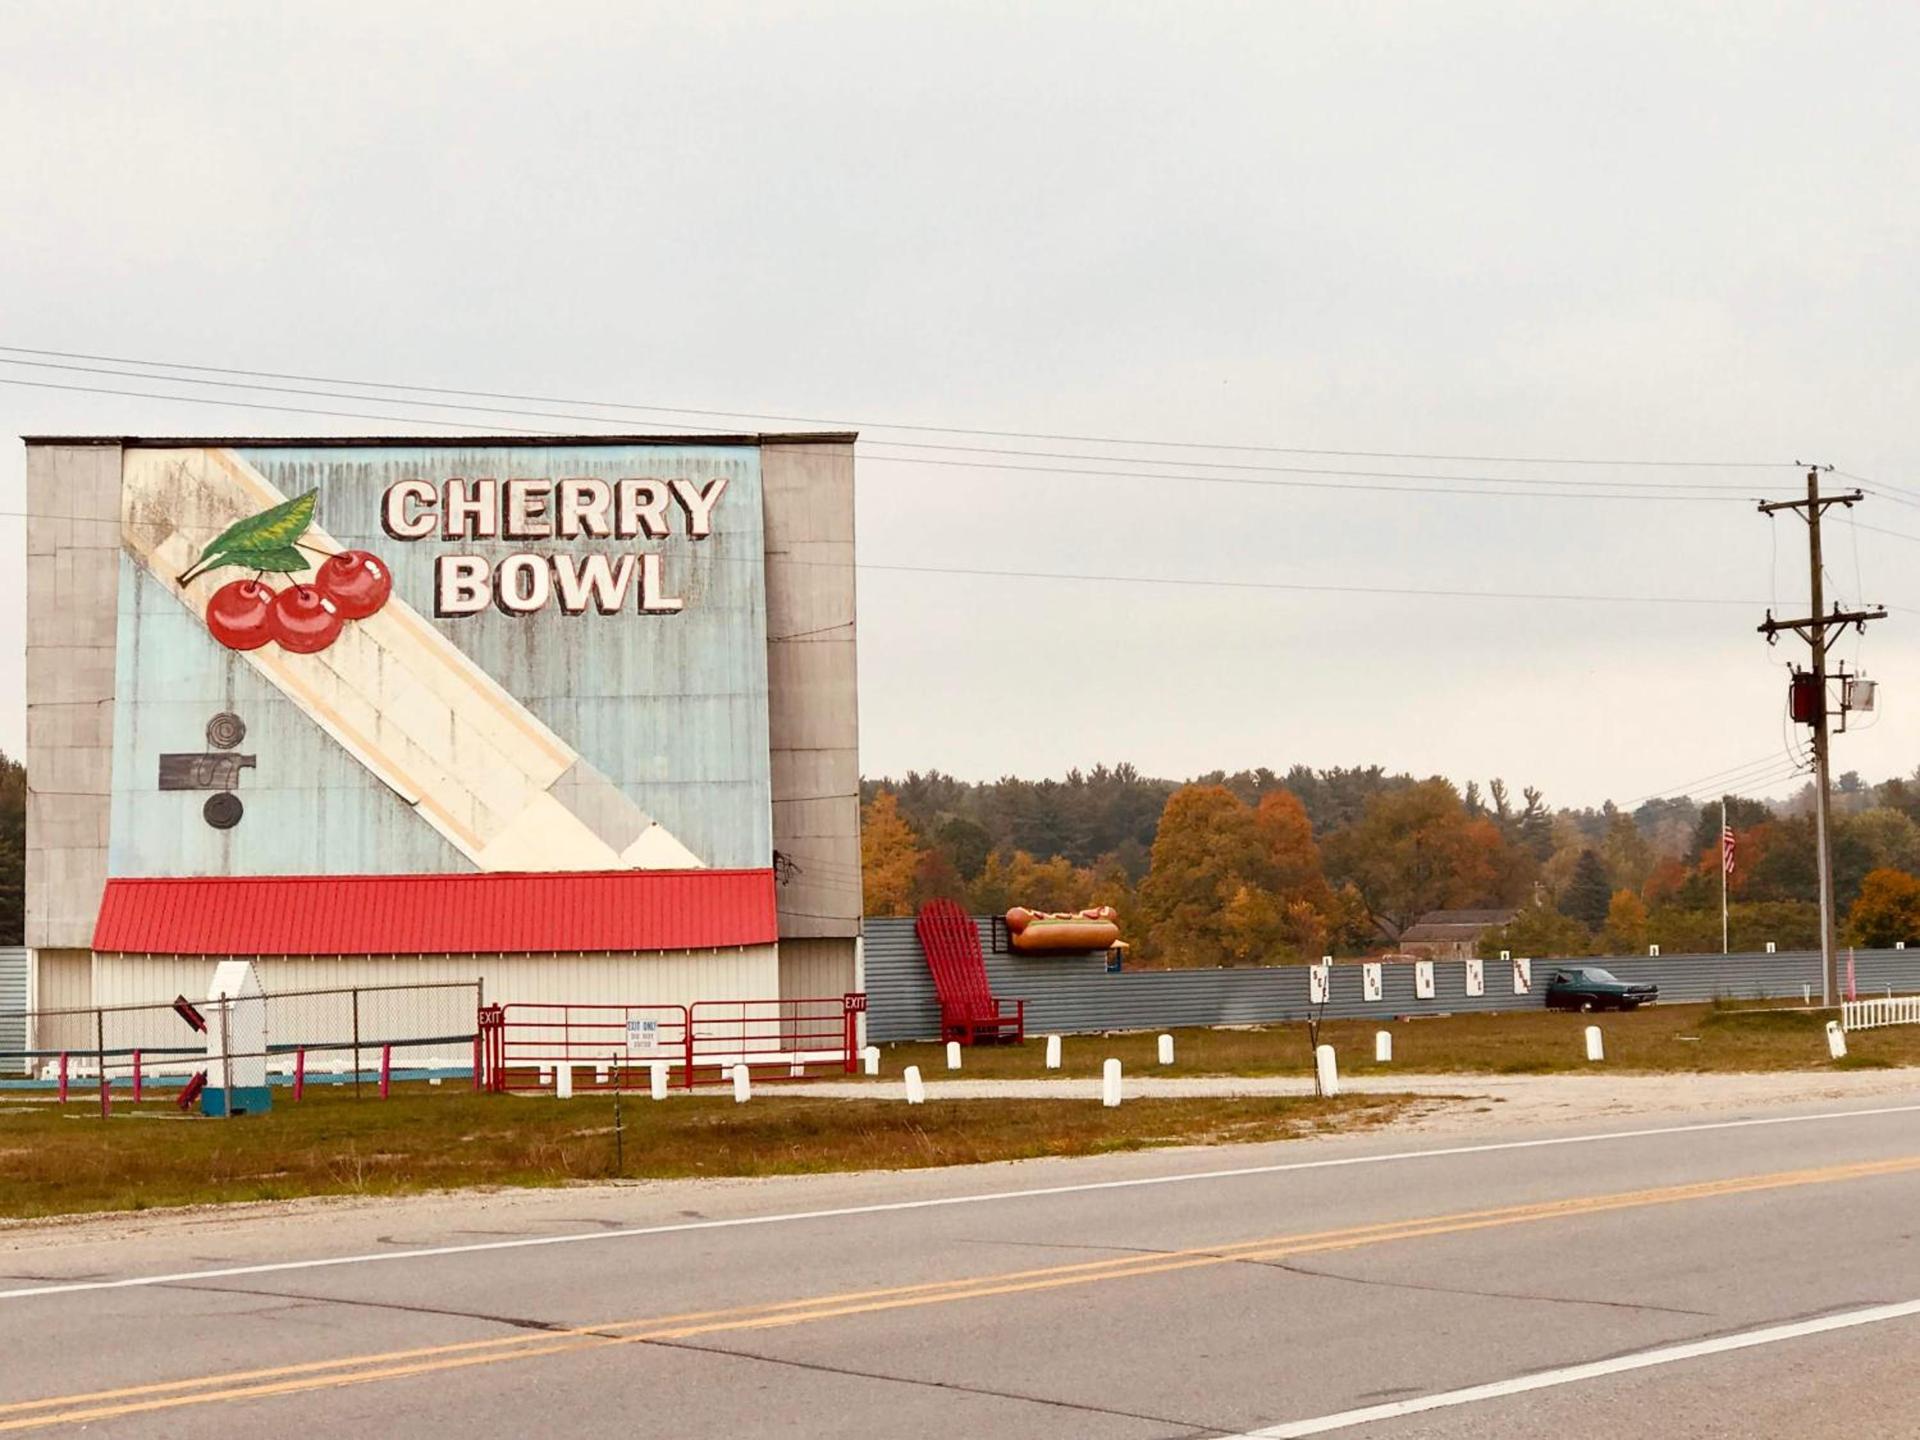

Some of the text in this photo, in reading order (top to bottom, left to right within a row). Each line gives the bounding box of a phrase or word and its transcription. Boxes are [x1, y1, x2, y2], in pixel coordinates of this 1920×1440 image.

[380, 477, 729, 542] CHERRY
[434, 552, 684, 619] BOWL
[479, 1010, 501, 1025] EXIT
[845, 996, 865, 1010] EXIT
